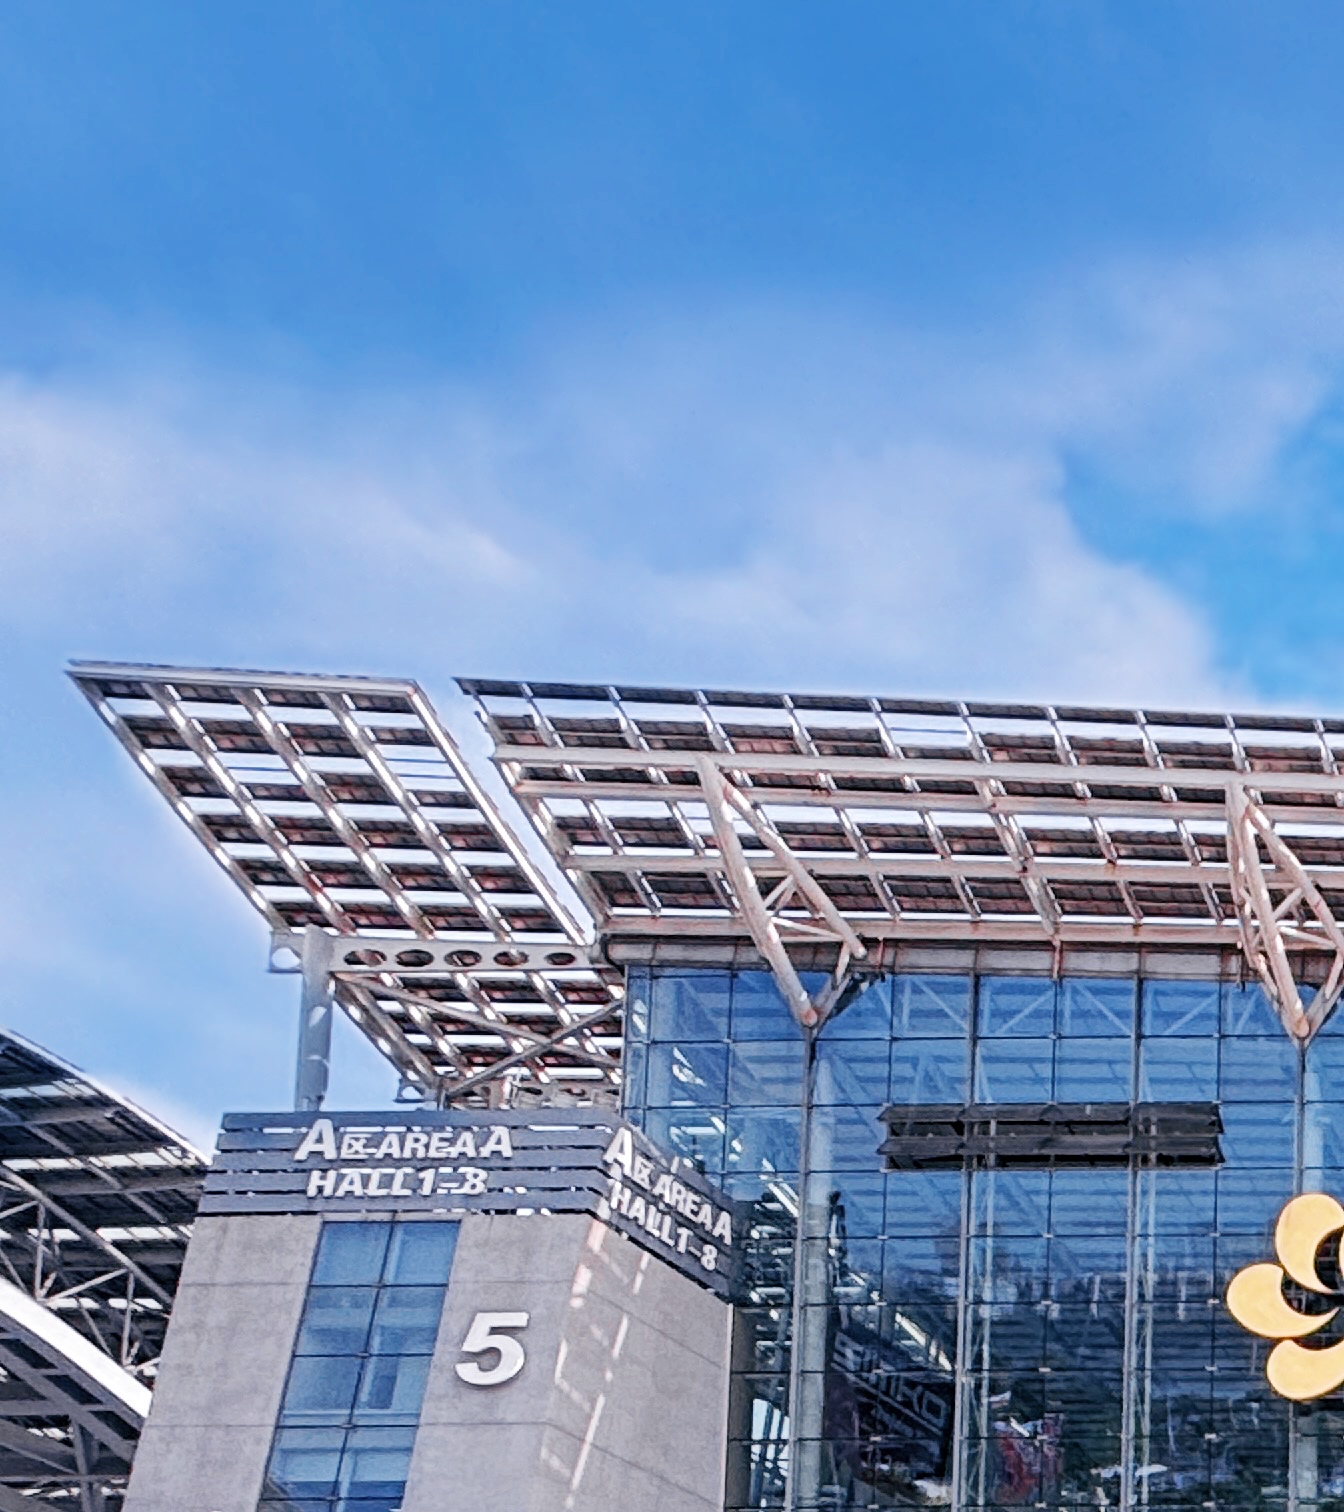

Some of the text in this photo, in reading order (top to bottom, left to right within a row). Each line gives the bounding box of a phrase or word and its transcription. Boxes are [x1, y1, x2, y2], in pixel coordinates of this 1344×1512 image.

[374, 1131, 477, 1159] AREA
[479, 1126, 514, 1158] A
[306, 1168, 488, 1197] HALL 1-8
[651, 1174, 713, 1231] AREA
[712, 1211, 732, 1246] A
[610, 1181, 718, 1271] HALL 1-8
[455, 1312, 529, 1386] 5
